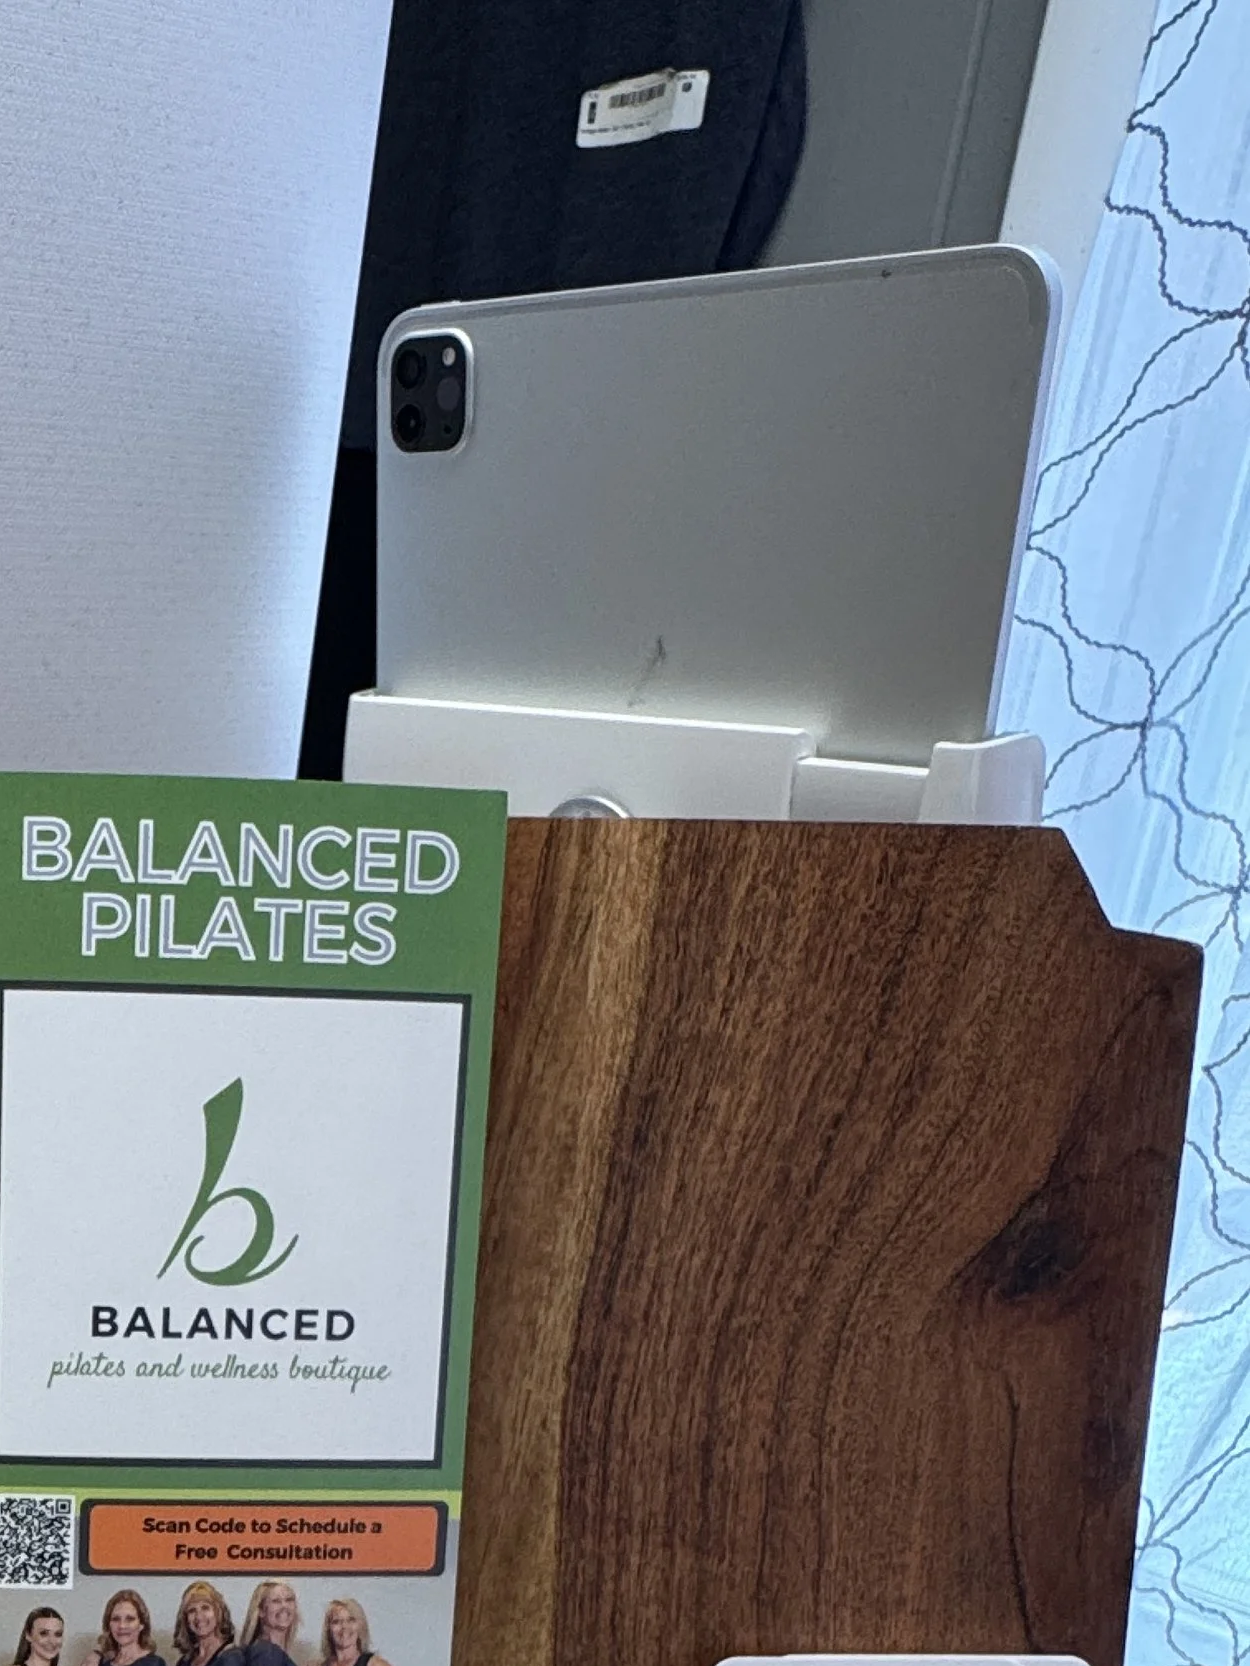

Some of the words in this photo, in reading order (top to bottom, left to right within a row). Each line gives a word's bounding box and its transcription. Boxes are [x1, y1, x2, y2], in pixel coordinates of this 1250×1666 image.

[21, 815, 460, 895] BALANCED
[80, 893, 398, 966] PILATES
[90, 1305, 356, 1341] BALANCED
[47, 1353, 126, 1391] pilates
[135, 1353, 185, 1379] and
[190, 1355, 279, 1380] wellness
[288, 1356, 392, 1393] boutique
[142, 1517, 191, 1535] Scan
[196, 1517, 246, 1535] Code
[251, 1519, 272, 1535] to
[275, 1518, 367, 1535] Schedule
[371, 1522, 383, 1535] a
[175, 1544, 217, 1561] Free
[227, 1544, 354, 1561] Consultation
